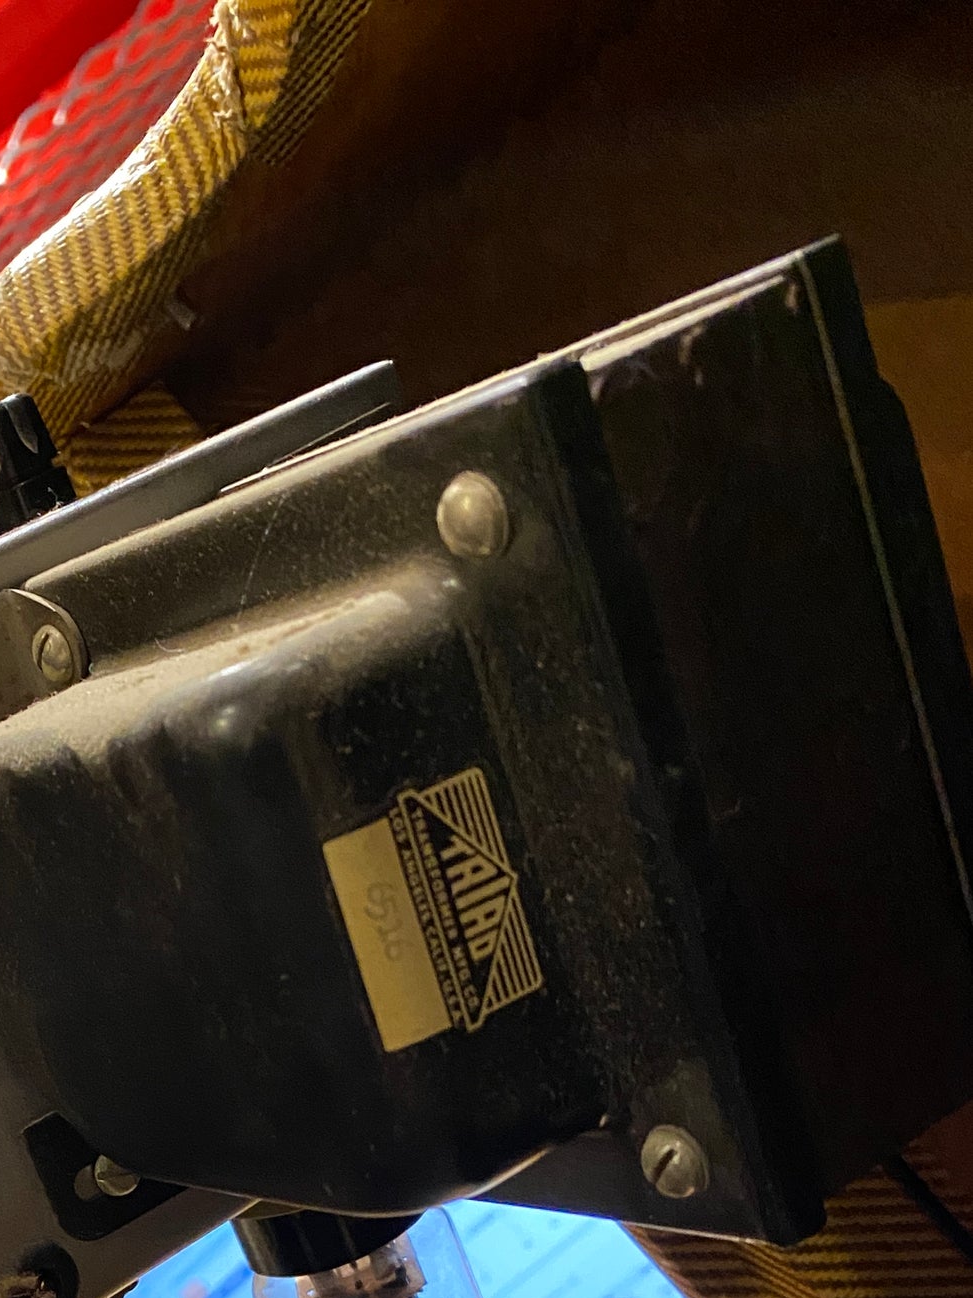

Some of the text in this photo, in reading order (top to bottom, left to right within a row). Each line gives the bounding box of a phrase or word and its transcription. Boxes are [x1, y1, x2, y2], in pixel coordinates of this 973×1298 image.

[389, 807, 408, 843] LOS
[411, 807, 460, 940] TRANSFORMER
[440, 834, 511, 964] TRIAD
